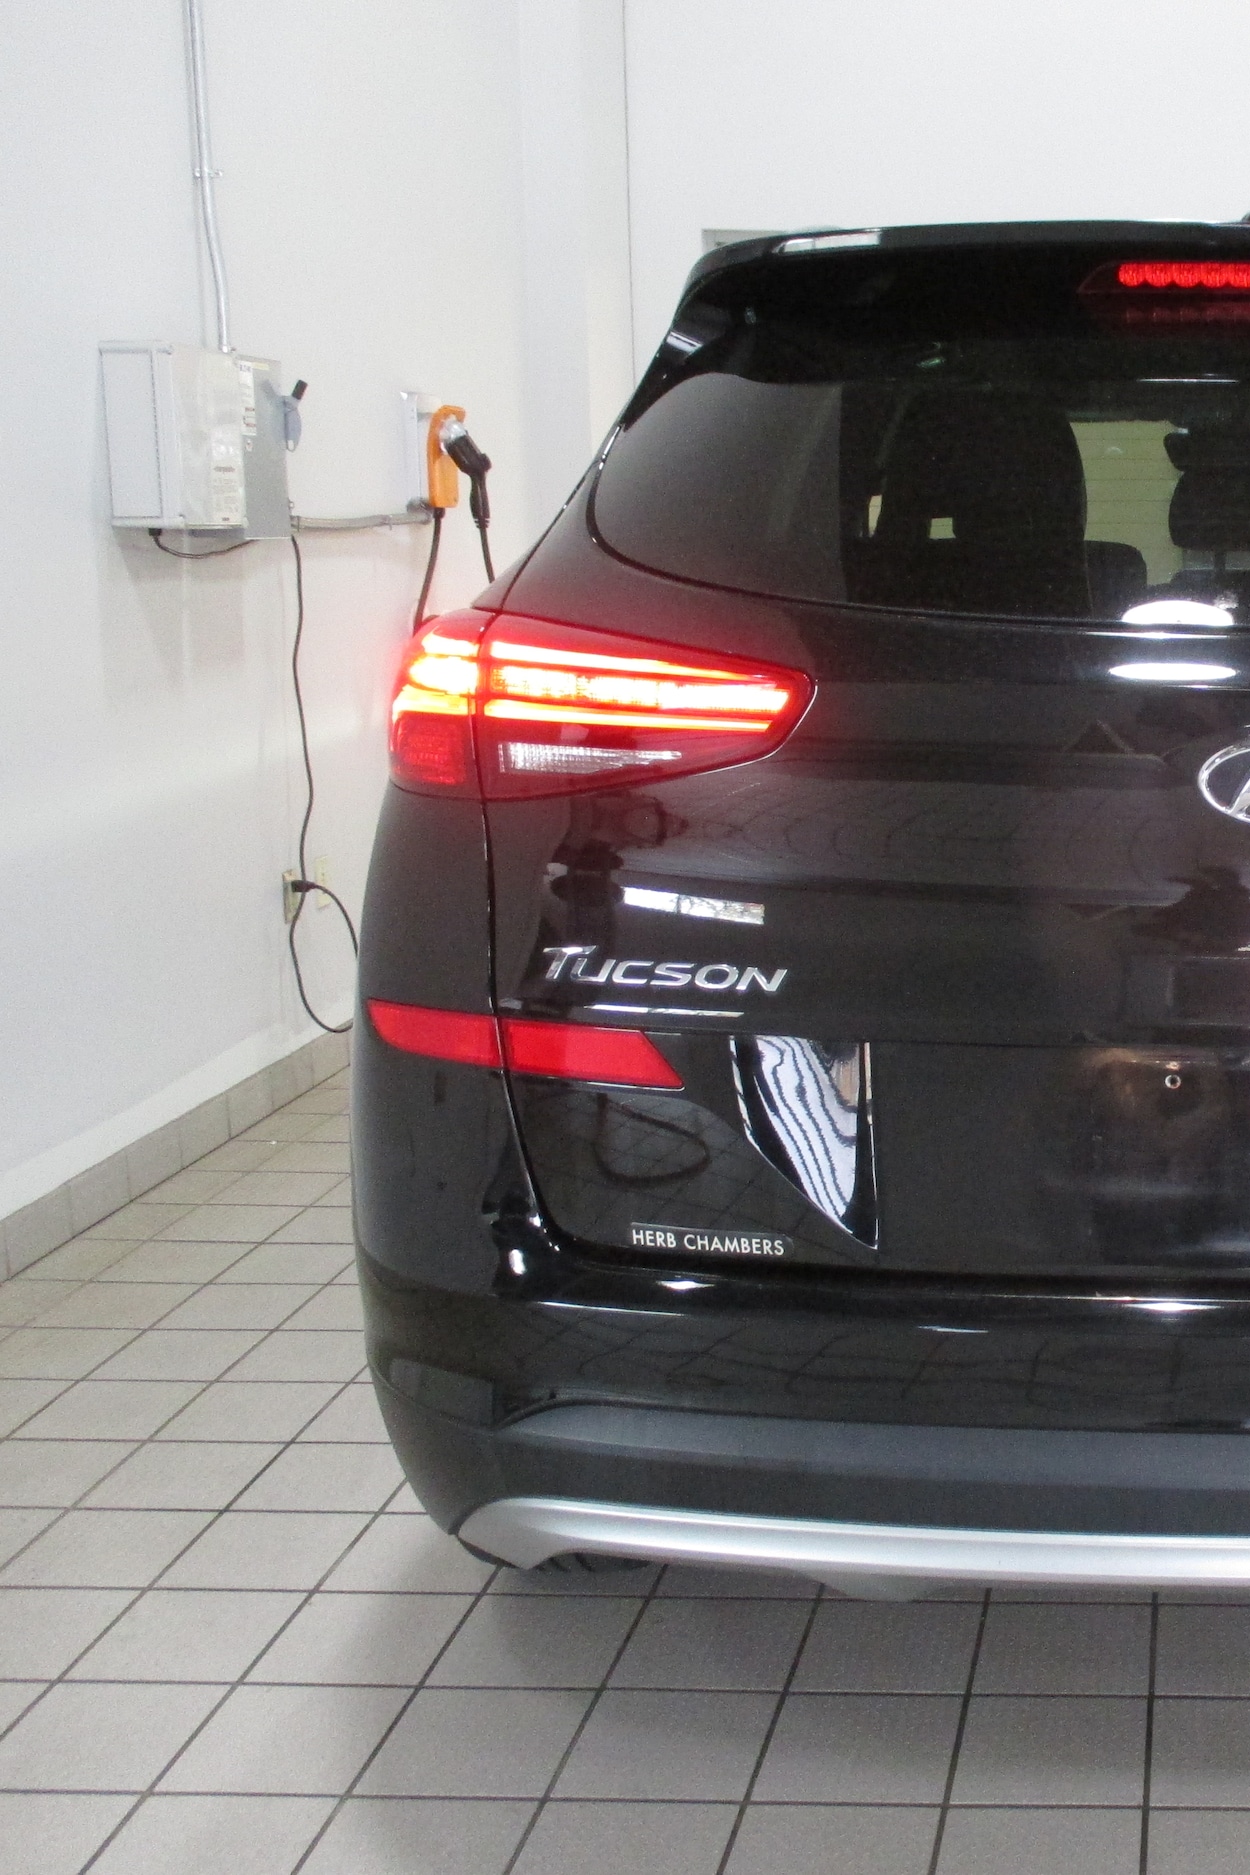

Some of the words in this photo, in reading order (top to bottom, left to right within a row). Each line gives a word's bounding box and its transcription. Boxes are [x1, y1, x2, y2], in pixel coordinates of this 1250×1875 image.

[543, 945, 788, 992] TUCSON
[632, 1229, 677, 1248] HERB
[683, 1234, 785, 1256] CHAMBERS
